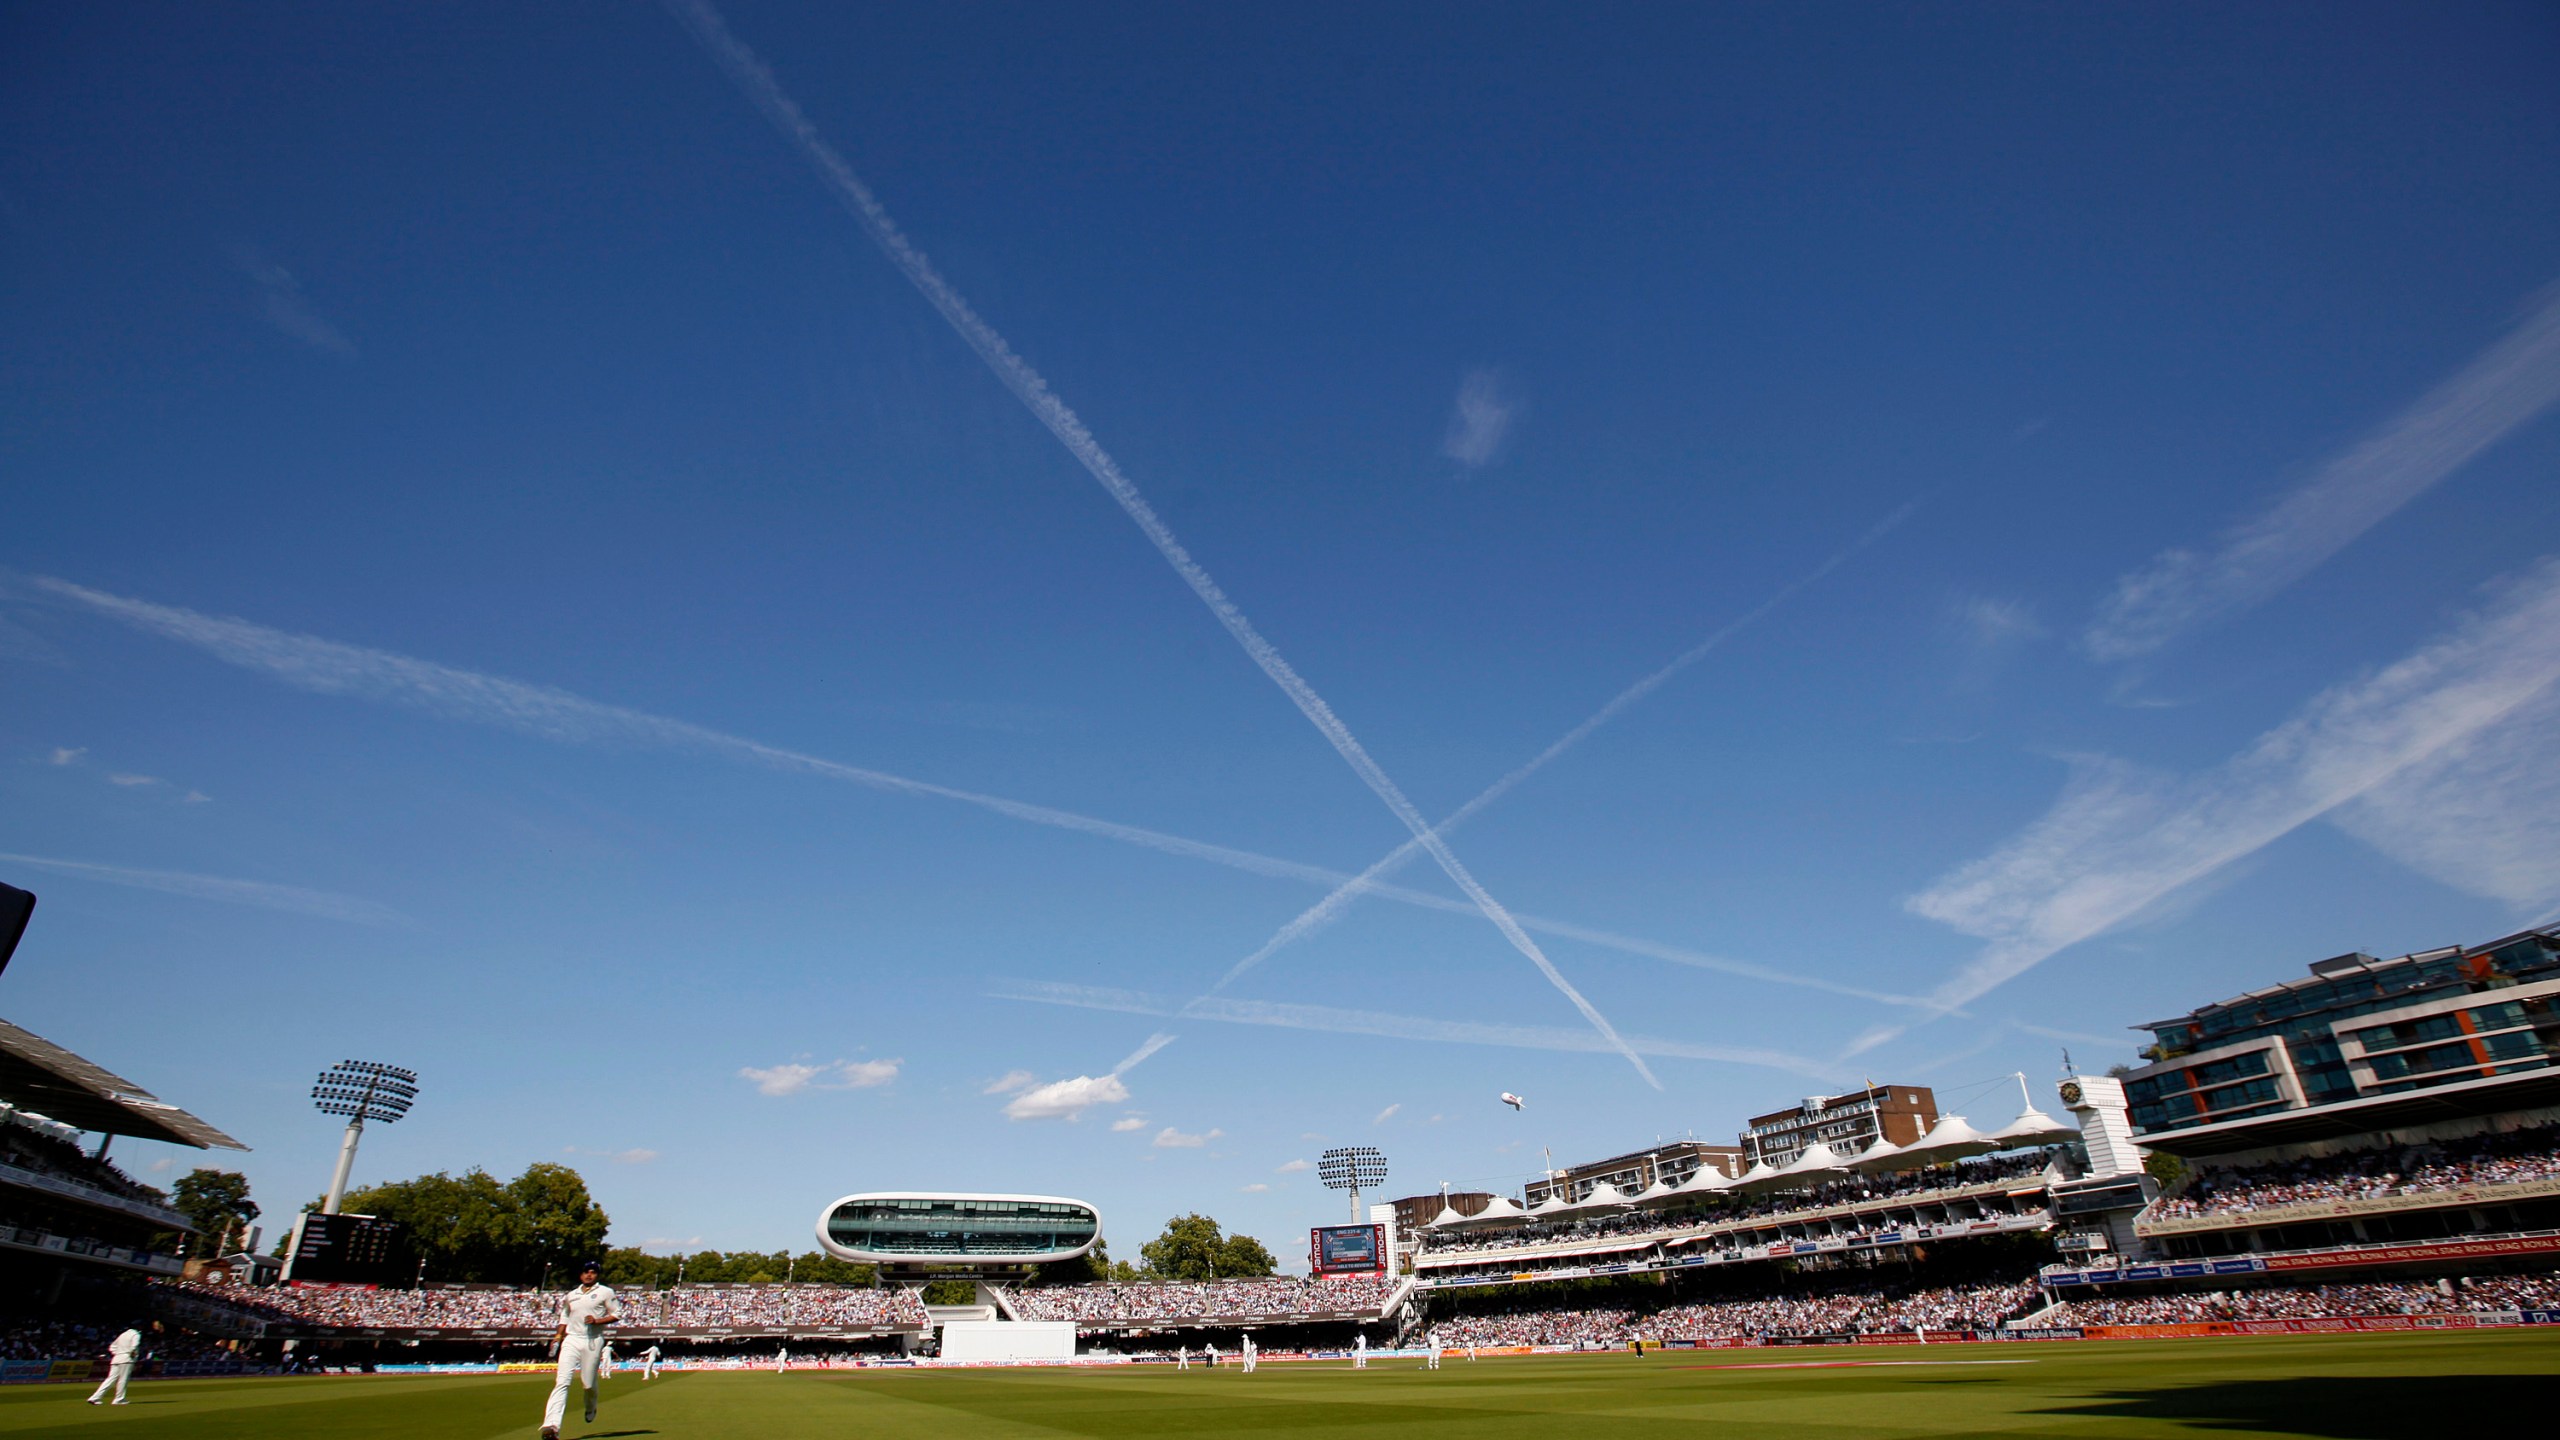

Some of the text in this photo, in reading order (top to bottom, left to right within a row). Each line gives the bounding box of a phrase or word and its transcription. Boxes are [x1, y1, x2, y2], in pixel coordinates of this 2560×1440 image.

[1312, 1229, 1322, 1271] npower
[1376, 1225, 1386, 1268] npower
[2359, 1251, 2387, 1261] ROYAL
[2386, 1250, 2411, 1259] STAG
[2410, 1248, 2440, 1258] ROYAL
[2439, 1246, 2464, 1255] STAG
[2464, 1244, 2496, 1253] ROYAL
[2495, 1242, 2522, 1251] STAG
[2522, 1239, 2556, 1249] ROYAL
[2445, 1314, 2476, 1327] HERO
[2479, 1316, 2498, 1325] WILL
[2021, 1329, 2080, 1341] Helpful Banking
[2111, 1326, 2145, 1337] ANGLO
[1706, 1339, 1731, 1348] Pedigree
